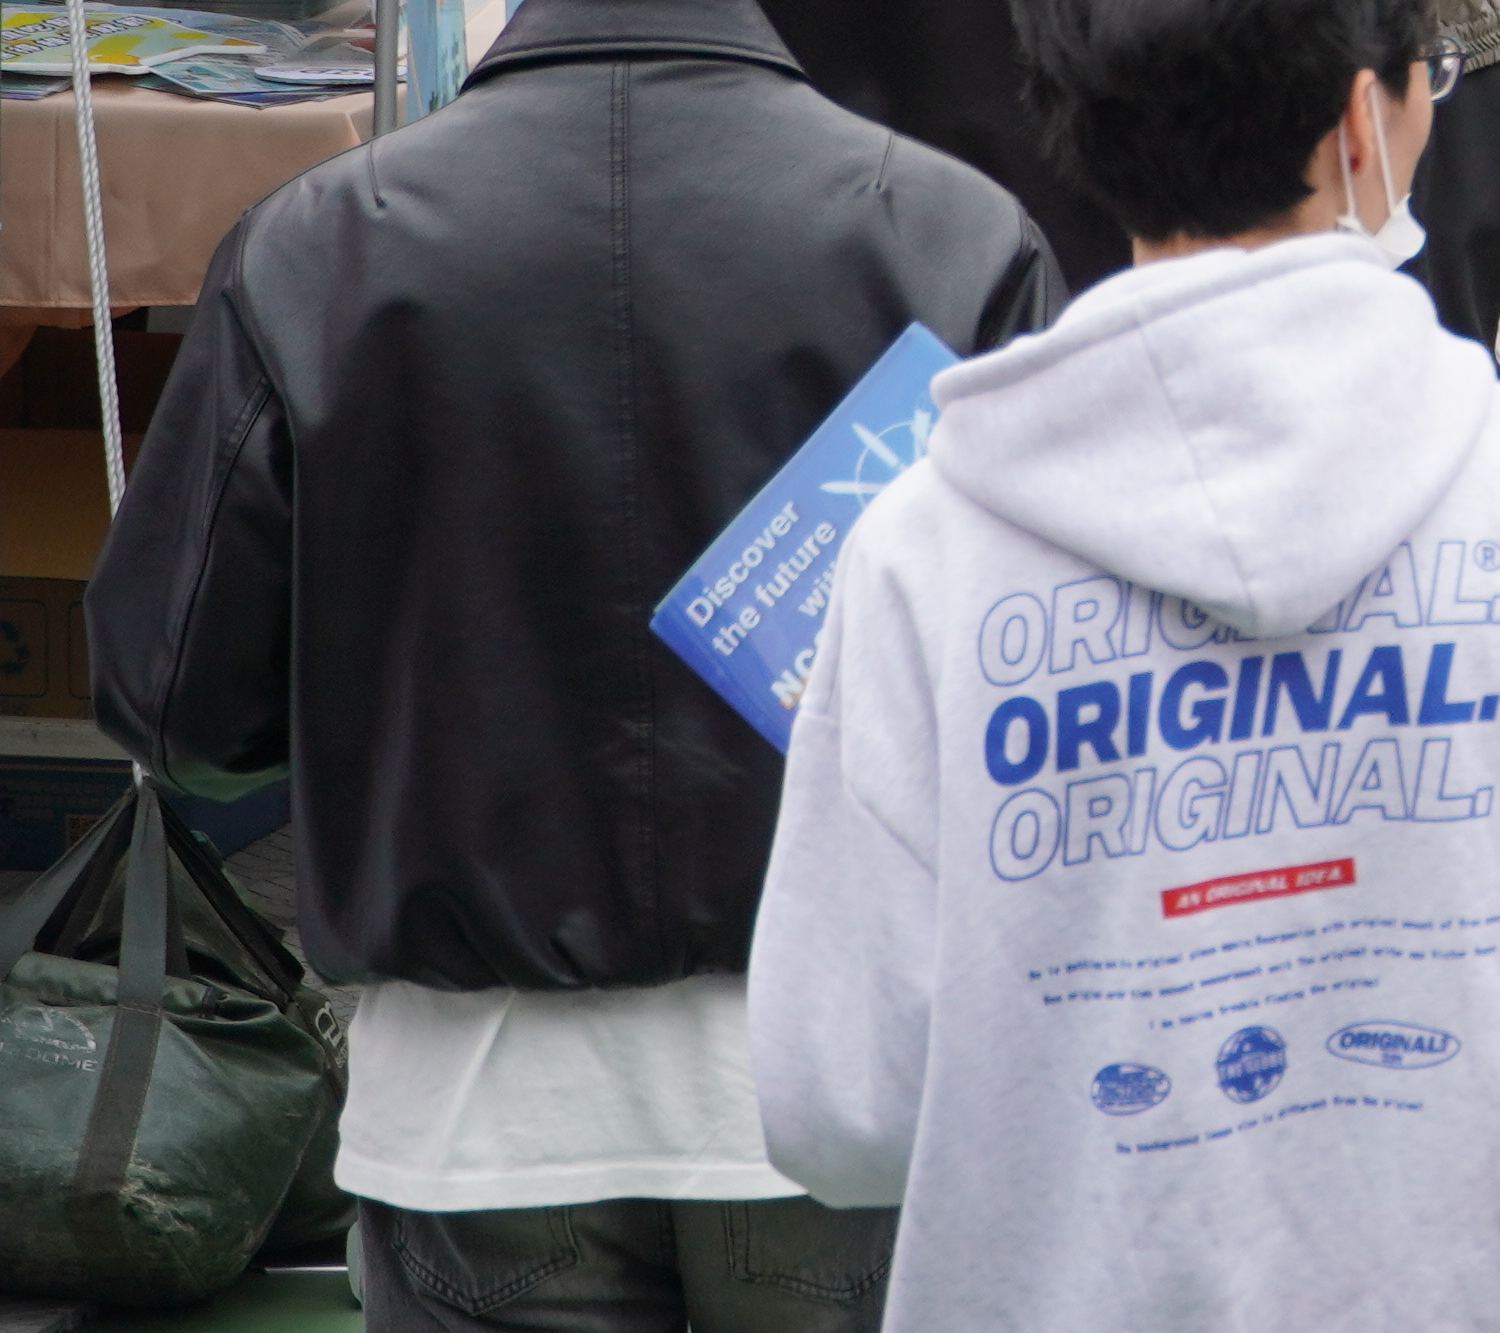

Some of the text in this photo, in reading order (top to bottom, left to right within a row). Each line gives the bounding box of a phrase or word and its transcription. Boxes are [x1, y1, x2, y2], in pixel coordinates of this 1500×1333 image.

[686, 499, 801, 627] Discover
[711, 520, 837, 658] the future
[985, 643, 1500, 786] ORIGINAL.
[989, 738, 1495, 882] ORIGINAL.
